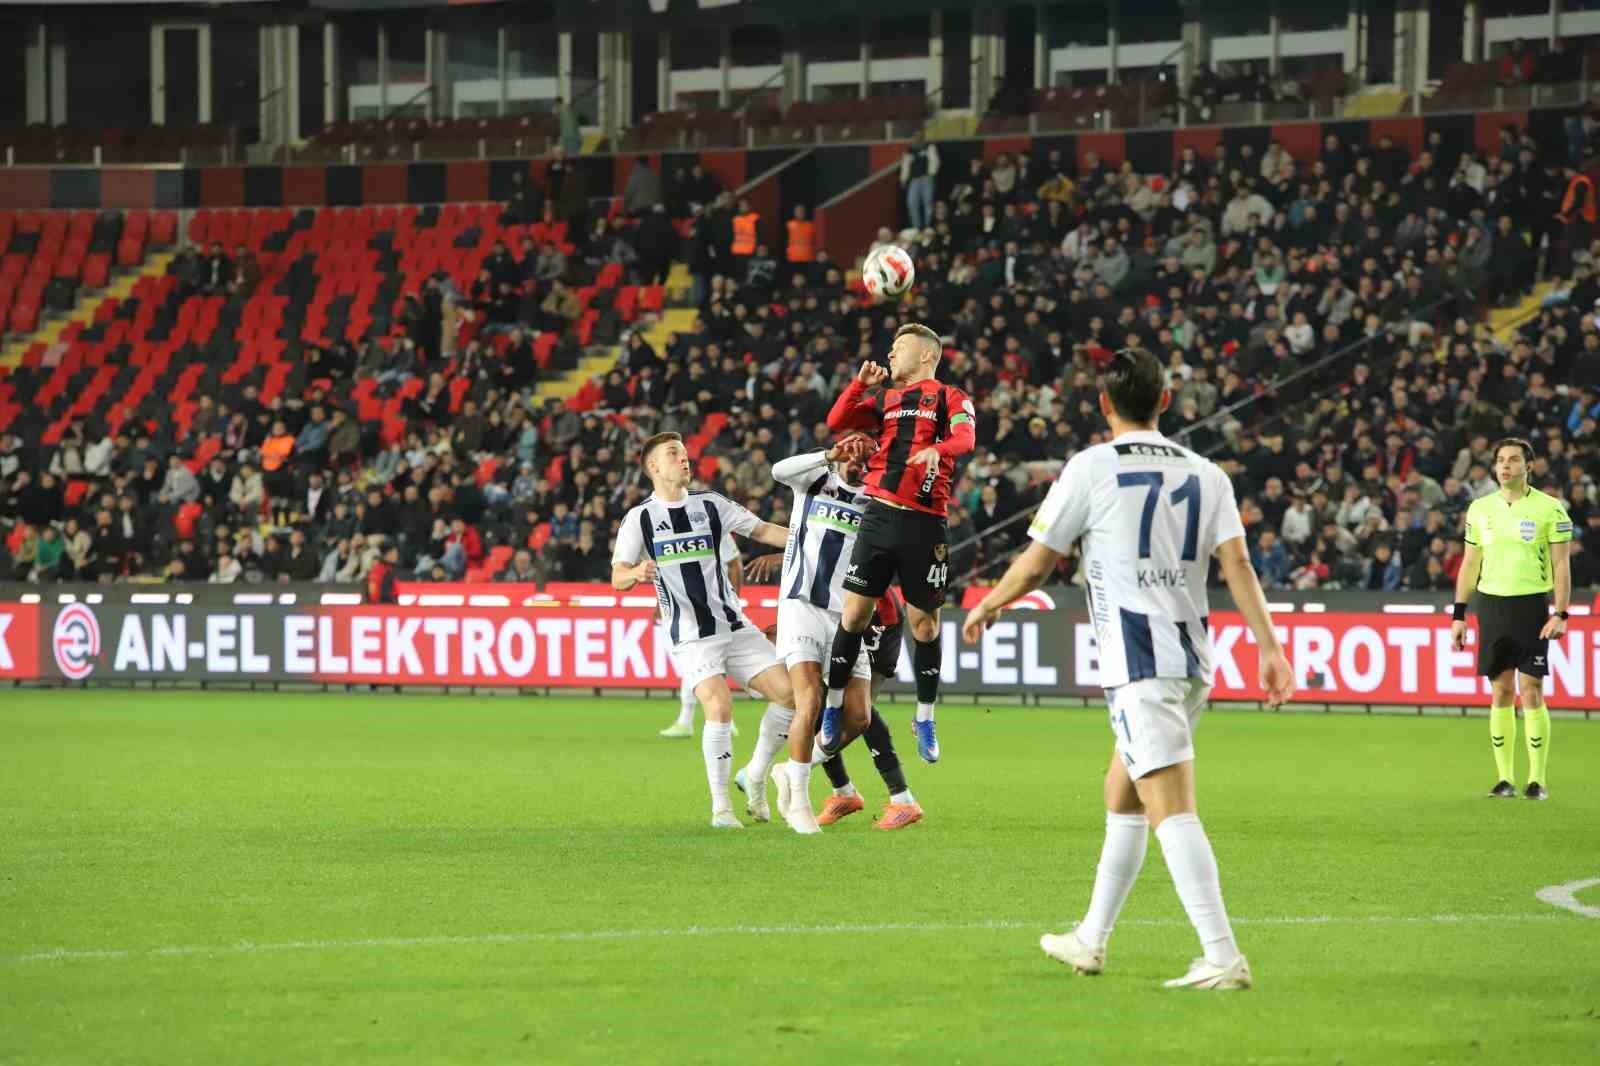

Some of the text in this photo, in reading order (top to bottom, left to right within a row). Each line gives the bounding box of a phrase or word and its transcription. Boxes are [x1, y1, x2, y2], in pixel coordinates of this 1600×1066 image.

[817, 504, 862, 527] aksa
[1116, 471, 1201, 562] 71
[663, 538, 708, 556] aksa
[114, 615, 271, 673] AN-EL
